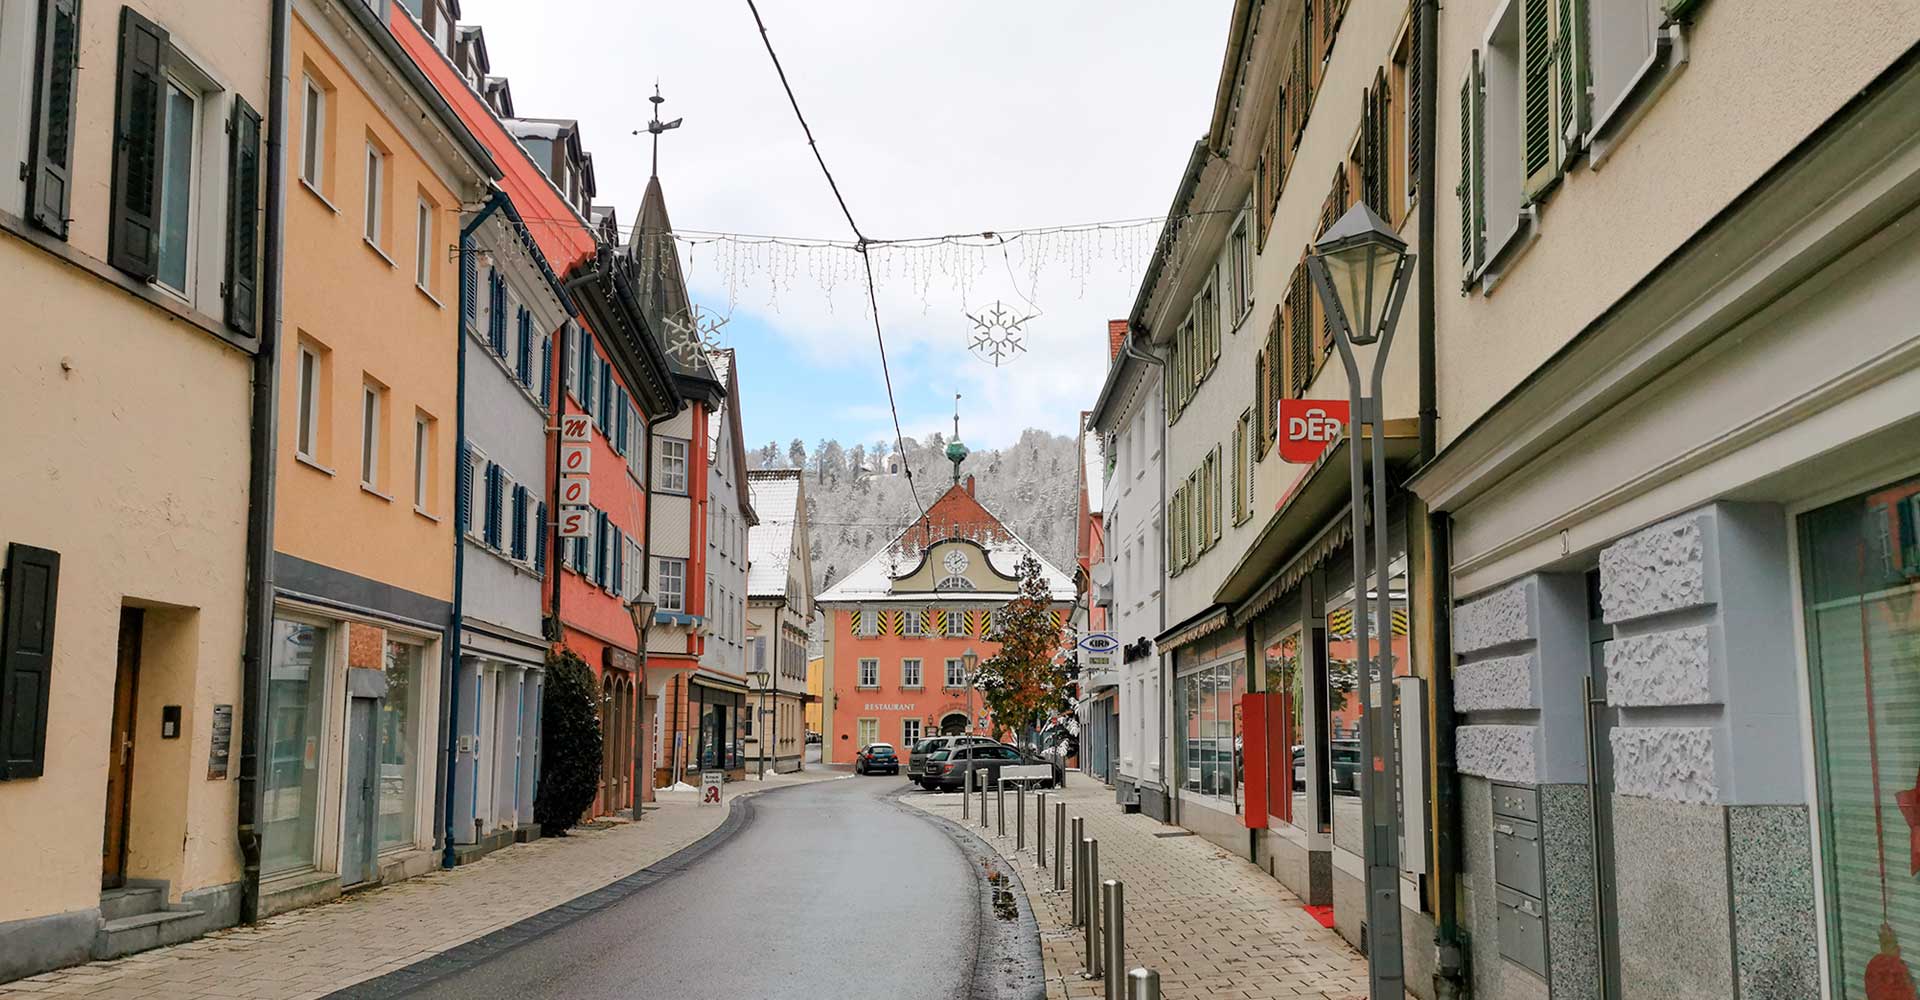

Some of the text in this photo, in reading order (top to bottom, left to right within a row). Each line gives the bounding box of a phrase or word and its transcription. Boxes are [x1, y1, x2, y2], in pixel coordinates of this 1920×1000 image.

[1289, 416, 1341, 441] DER
[563, 419, 587, 534] MOOS
[1089, 639, 1110, 648] KIRN
[864, 703, 915, 711] RESTAURANT
